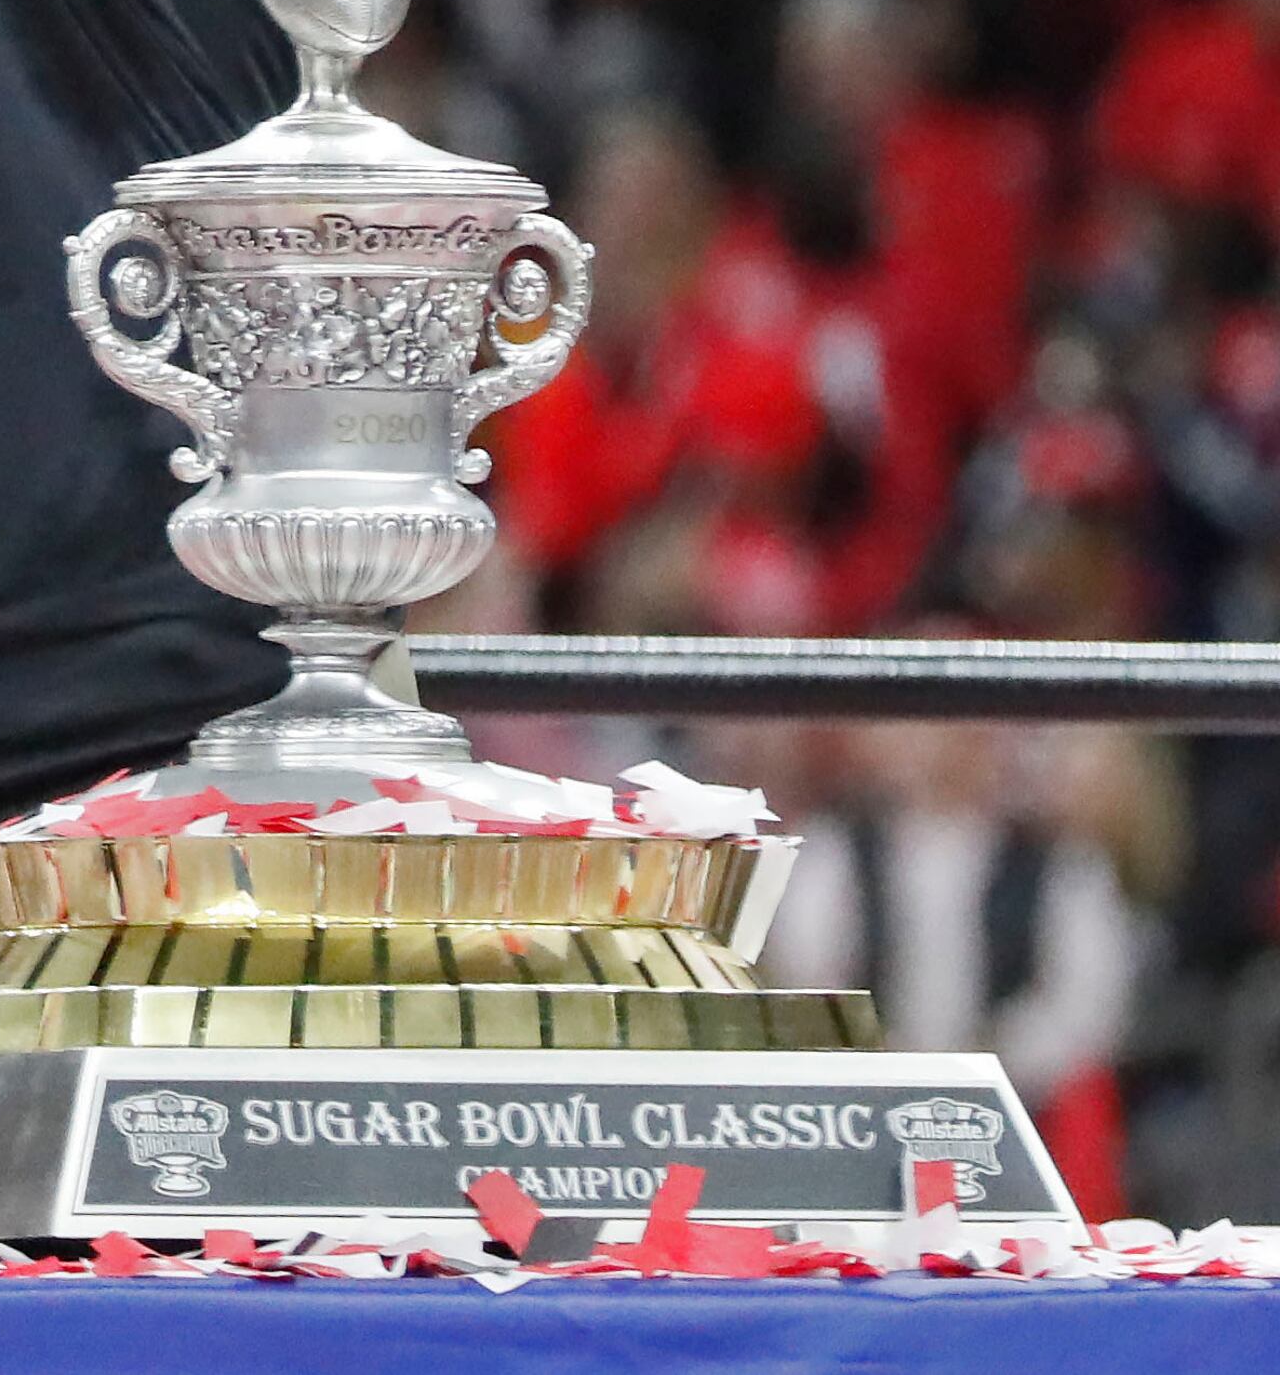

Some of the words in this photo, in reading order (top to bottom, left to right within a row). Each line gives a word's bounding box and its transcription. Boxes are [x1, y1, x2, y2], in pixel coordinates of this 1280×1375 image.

[336, 413, 425, 445] 2020
[133, 1112, 209, 1132] Allstate
[241, 1098, 450, 1149] SUGAR
[457, 1092, 622, 1149] BOWL
[632, 1101, 875, 1151] CLASSIC
[908, 1119, 986, 1139] Allstate
[457, 1164, 668, 1201] CAMPIO
